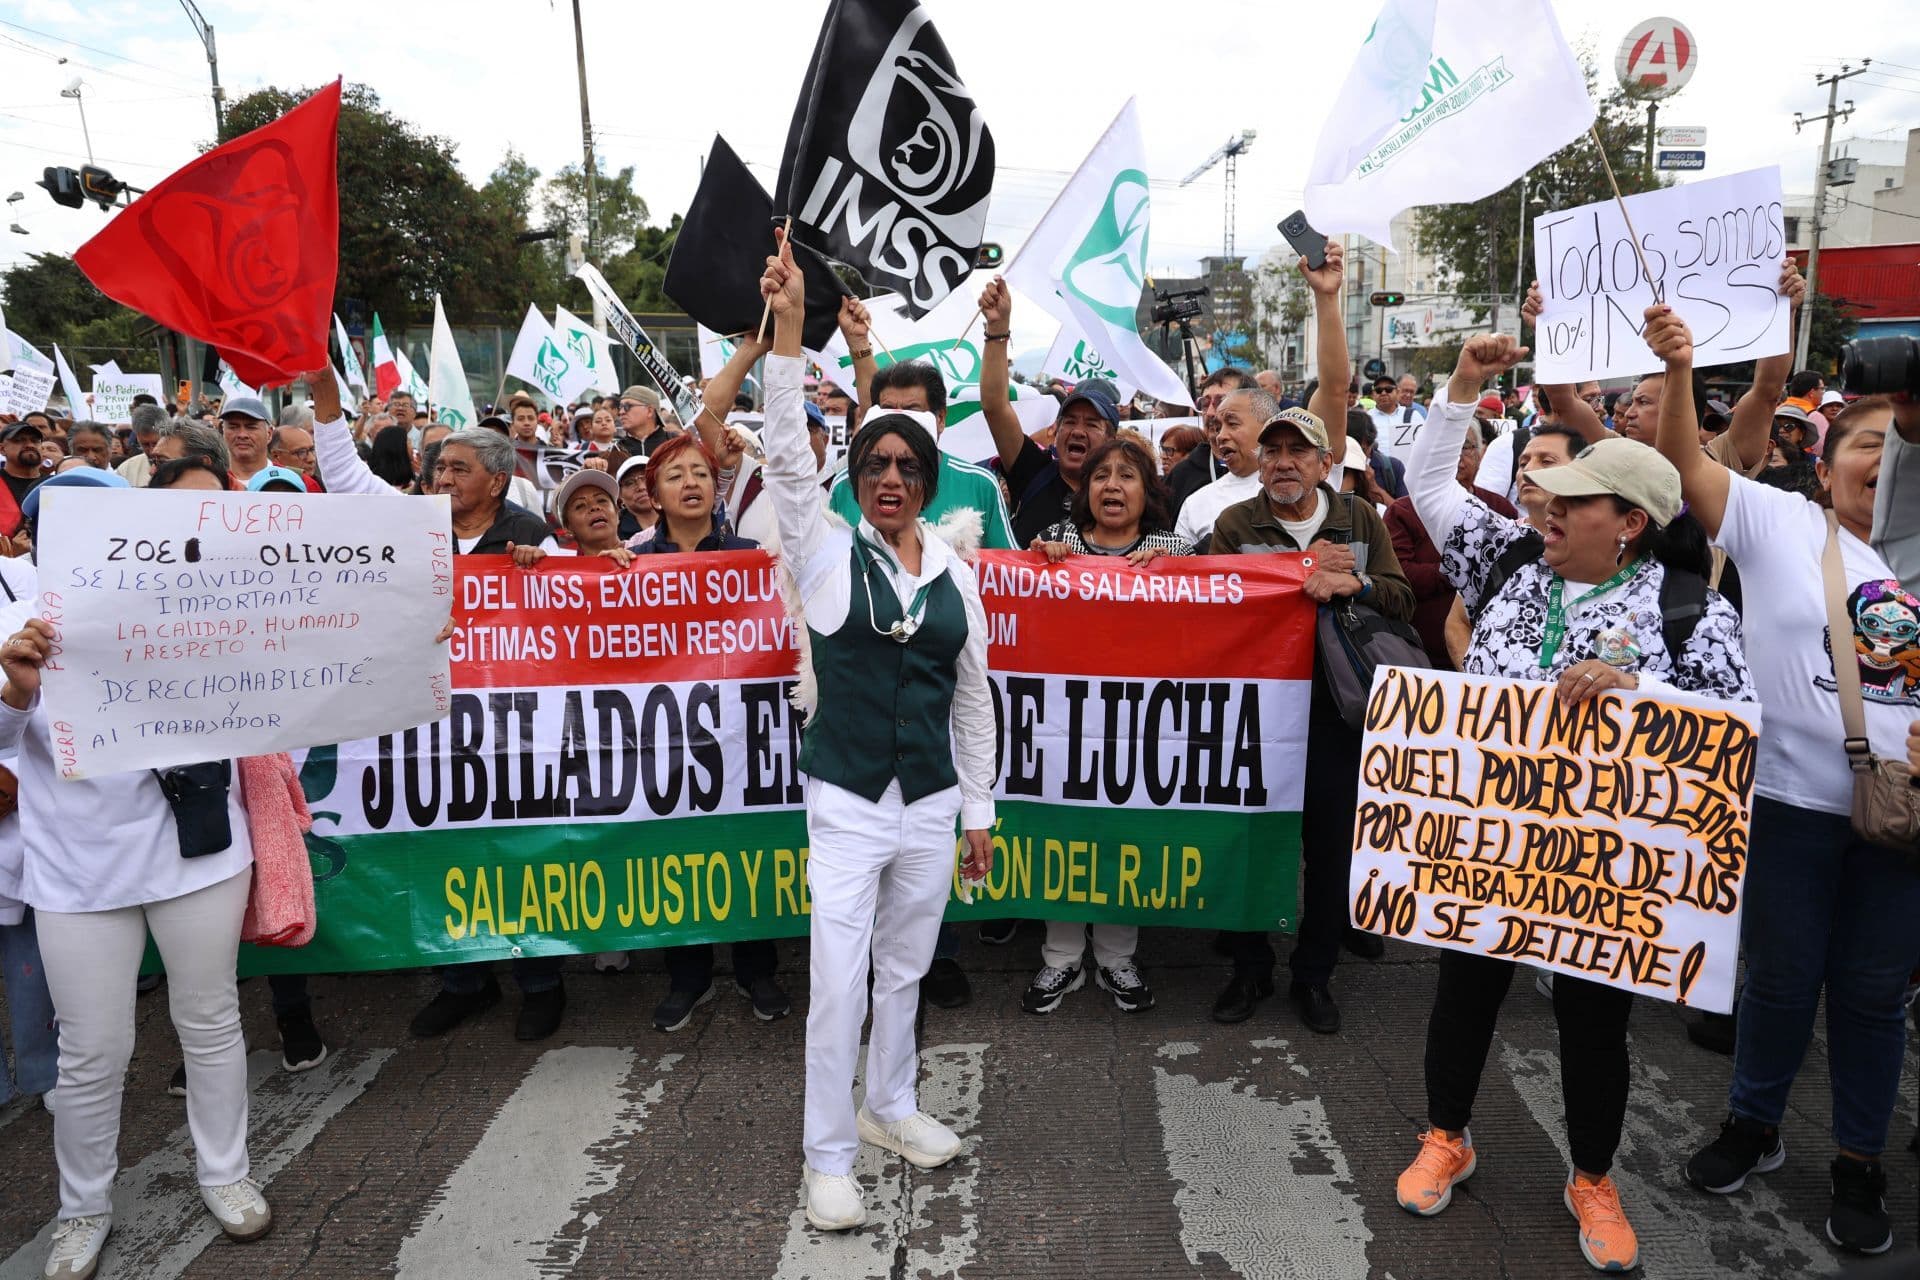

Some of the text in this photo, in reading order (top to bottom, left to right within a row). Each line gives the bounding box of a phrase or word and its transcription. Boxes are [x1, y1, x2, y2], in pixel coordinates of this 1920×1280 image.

[799, 156, 971, 311] IMSS
[1540, 212, 1667, 300] Todos
[1547, 317, 1587, 356] 10%
[97, 380, 112, 394] No
[197, 501, 304, 534] FUERA
[107, 538, 177, 564] ZOE
[428, 531, 449, 597] FUERA
[71, 567, 104, 588] SE
[118, 569, 168, 591] LES
[292, 568, 322, 584] LO
[336, 568, 388, 584] MAS
[156, 587, 321, 615] IMPORTANTE
[463, 574, 517, 611] DEL
[523, 573, 592, 615] IMSS,
[601, 570, 697, 608] EXIGEN
[705, 567, 784, 605] SOLU
[1079, 571, 1244, 604] SALARIALES
[118, 623, 147, 641] LA
[144, 640, 244, 661] RESPETO
[562, 625, 582, 660] Y
[589, 622, 676, 660] DEBEN
[228, 702, 240, 715] Y
[428, 672, 448, 712] FUERA
[134, 713, 281, 738] TRABAJADOR
[1456, 684, 1546, 747] HAY
[1541, 692, 1623, 756] MAS
[53, 720, 80, 779] FUERA
[362, 683, 725, 830] JUBILADOS
[1063, 679, 1268, 807] LUCHA
[1476, 748, 1584, 819] PODER
[1674, 780, 1748, 872] IMSS
[1356, 801, 1740, 915] POR QUE EL PODER DE LOS
[445, 860, 606, 940] SALARIO
[617, 850, 732, 929] JUSTO
[740, 849, 764, 918] Y
[1044, 838, 1108, 905] DEL
[1118, 844, 1205, 911] R.J.P.
[1408, 860, 1664, 940] TRABAJADORES
[1425, 901, 1485, 943] SE
[1487, 915, 1706, 1006] DETIENE!
